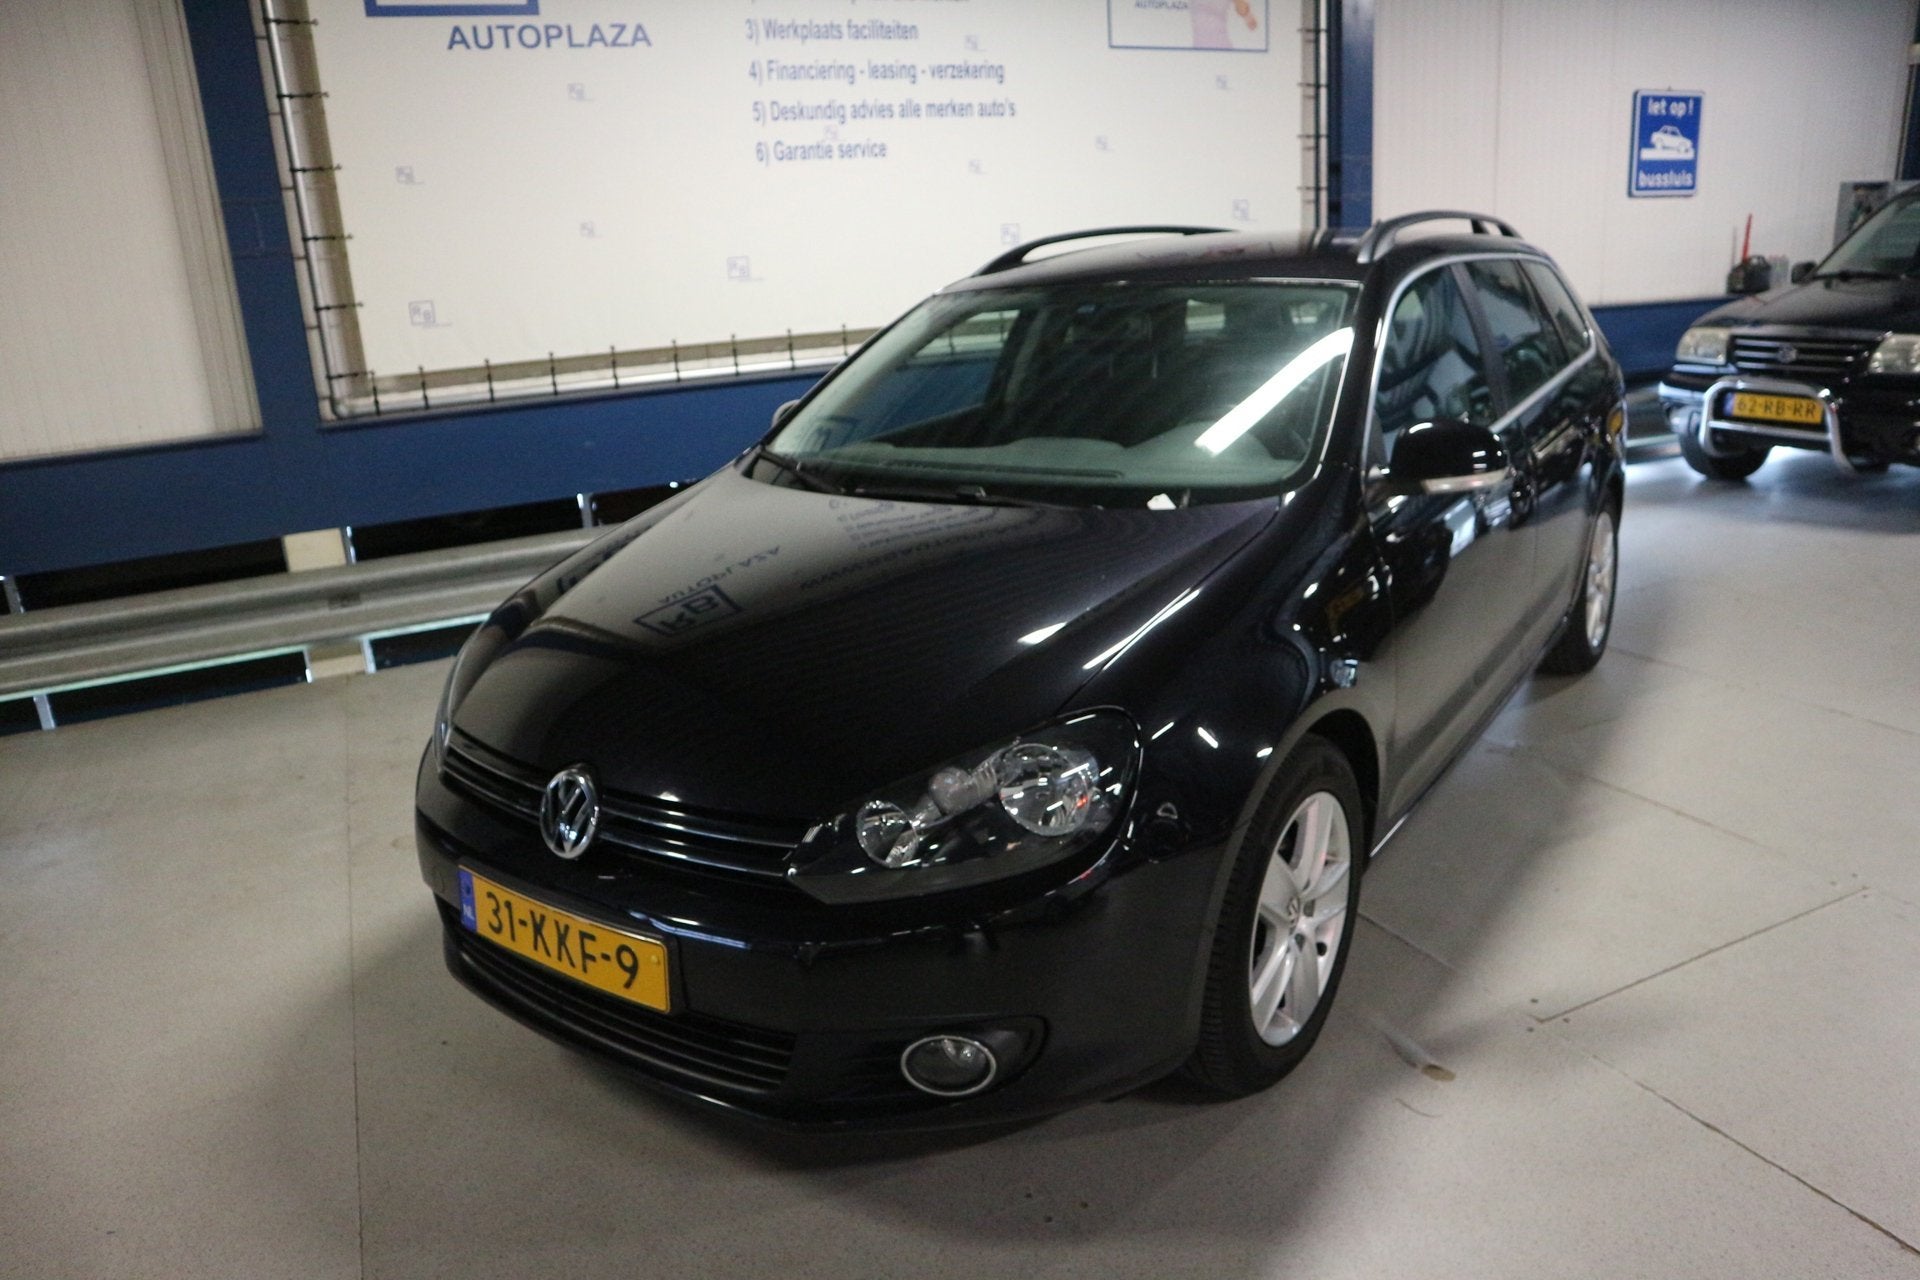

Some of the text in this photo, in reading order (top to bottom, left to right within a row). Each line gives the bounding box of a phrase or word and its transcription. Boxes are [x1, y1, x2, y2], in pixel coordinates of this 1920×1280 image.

[447, 24, 651, 50] AUTOPLAZA
[746, 18, 918, 43] 3) Werkplaats faciliteiten
[749, 62, 763, 86] 4)
[766, 60, 856, 84] Financiering
[868, 60, 918, 84] leasing
[930, 60, 1005, 83] verzekering
[752, 98, 1017, 125] 5) Deskundig advies alle merken auto's
[1648, 98, 1666, 115] let
[755, 140, 887, 166] 6) Garantie service
[486, 891, 639, 989] 31-KKF-9
